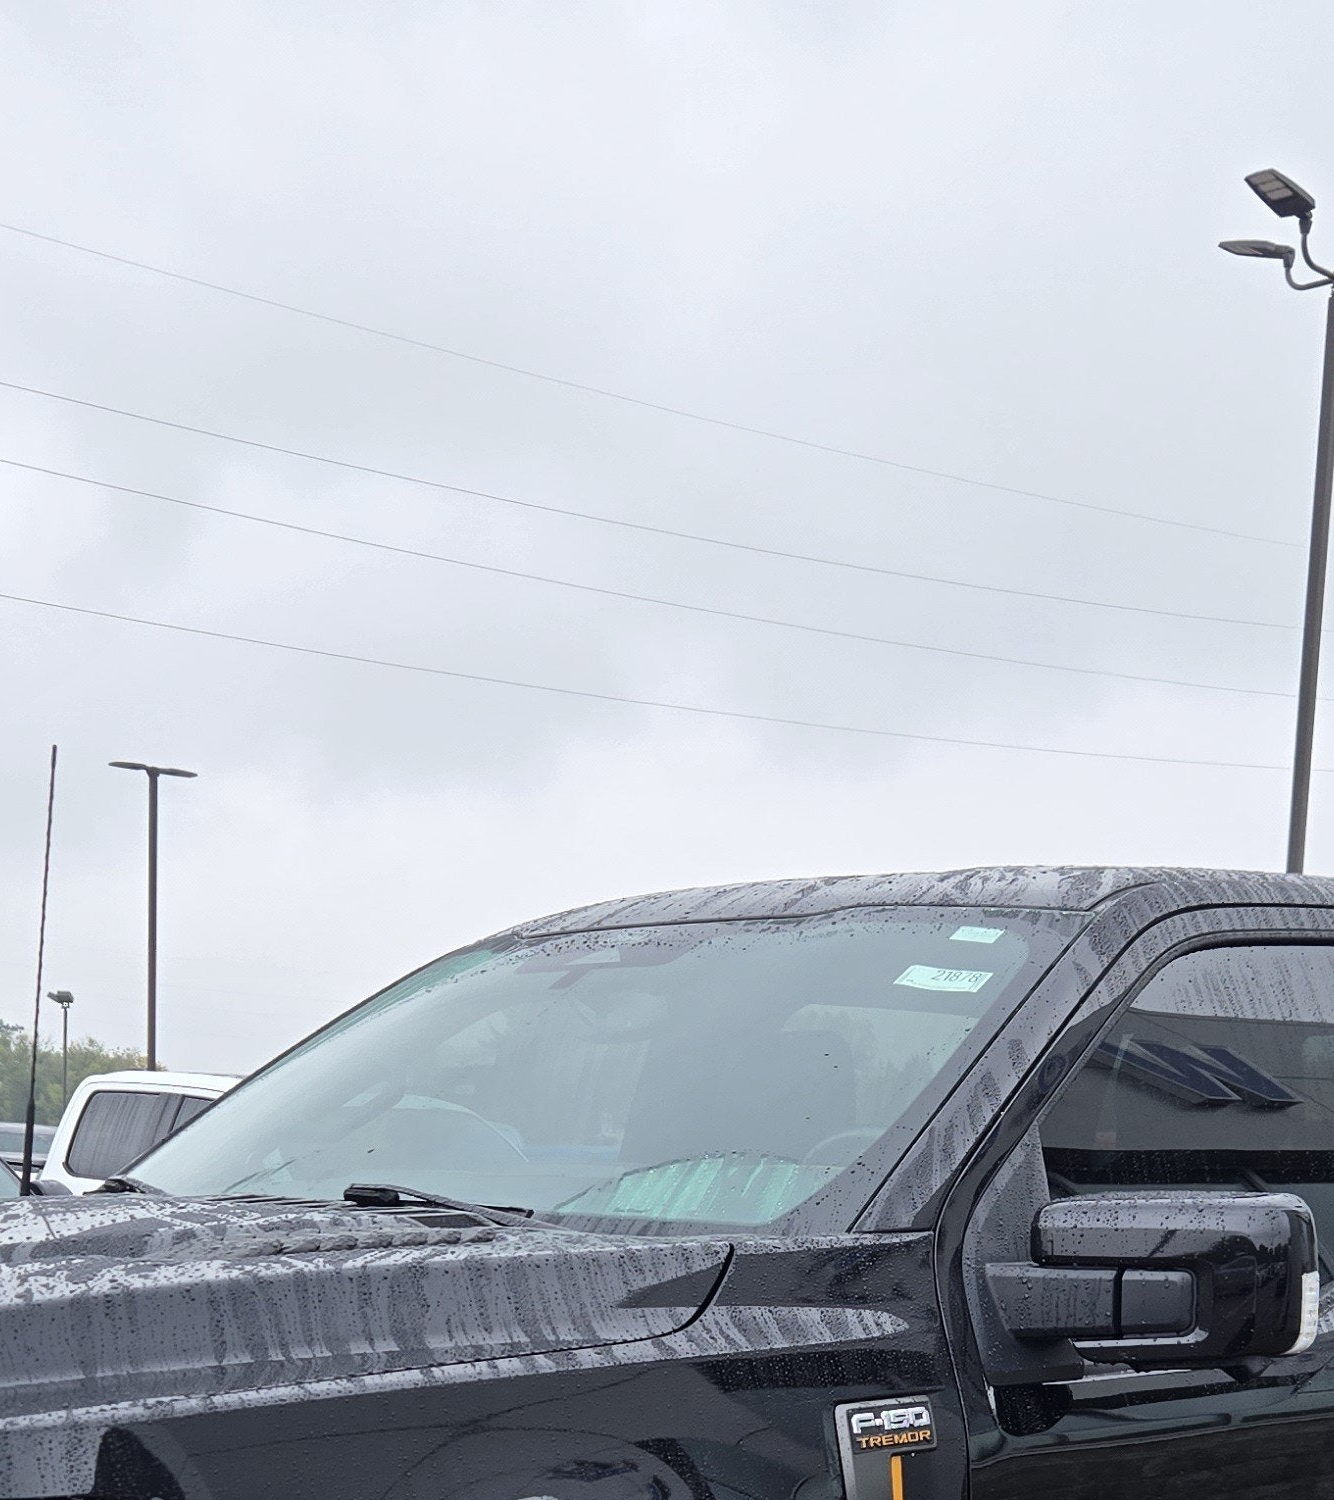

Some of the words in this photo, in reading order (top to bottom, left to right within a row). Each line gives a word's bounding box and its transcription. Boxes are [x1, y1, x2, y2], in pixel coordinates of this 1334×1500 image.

[931, 969, 982, 983] 21878
[851, 1406, 931, 1434] F-150
[856, 1429, 931, 1449] TREMOR
